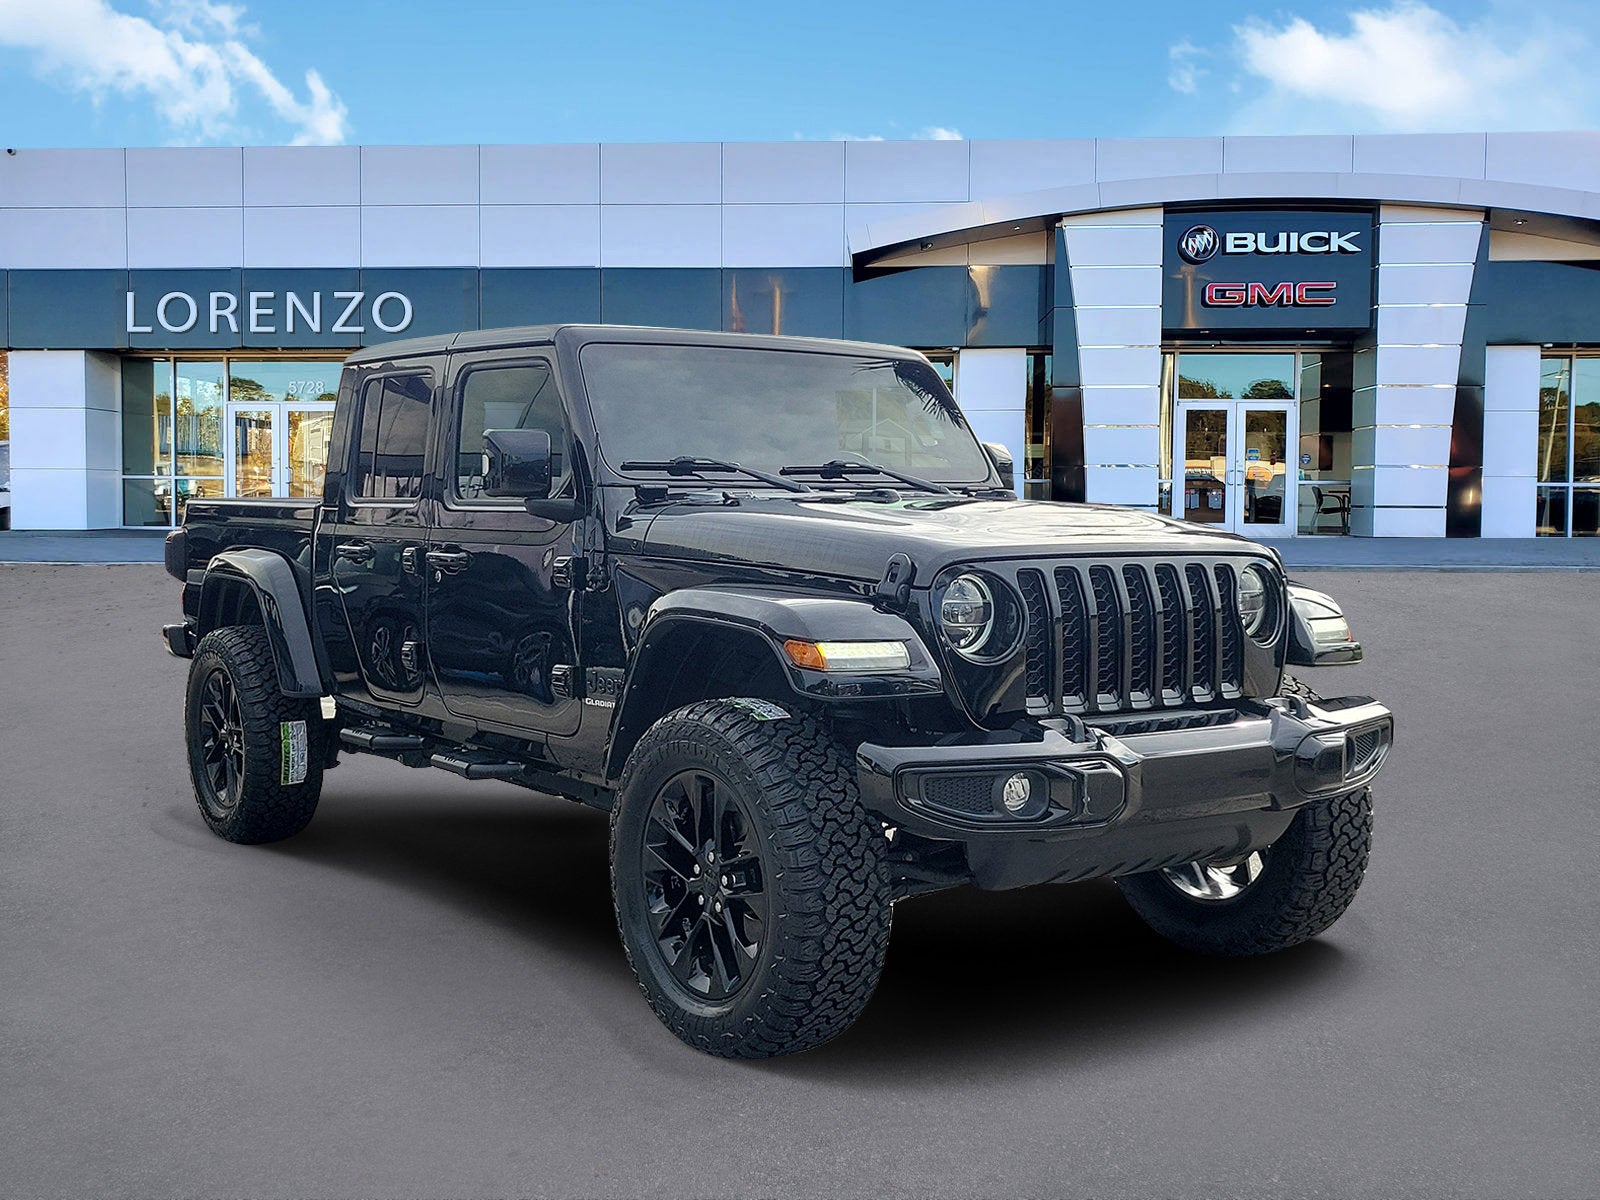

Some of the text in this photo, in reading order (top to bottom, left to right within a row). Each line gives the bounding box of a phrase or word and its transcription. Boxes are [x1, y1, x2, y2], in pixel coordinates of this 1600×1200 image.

[1225, 231, 1362, 253] BUICK
[1204, 281, 1337, 305] GMC
[126, 291, 414, 333] LORENZO
[288, 381, 325, 394] 5728
[585, 697, 616, 709] GLADIAT
